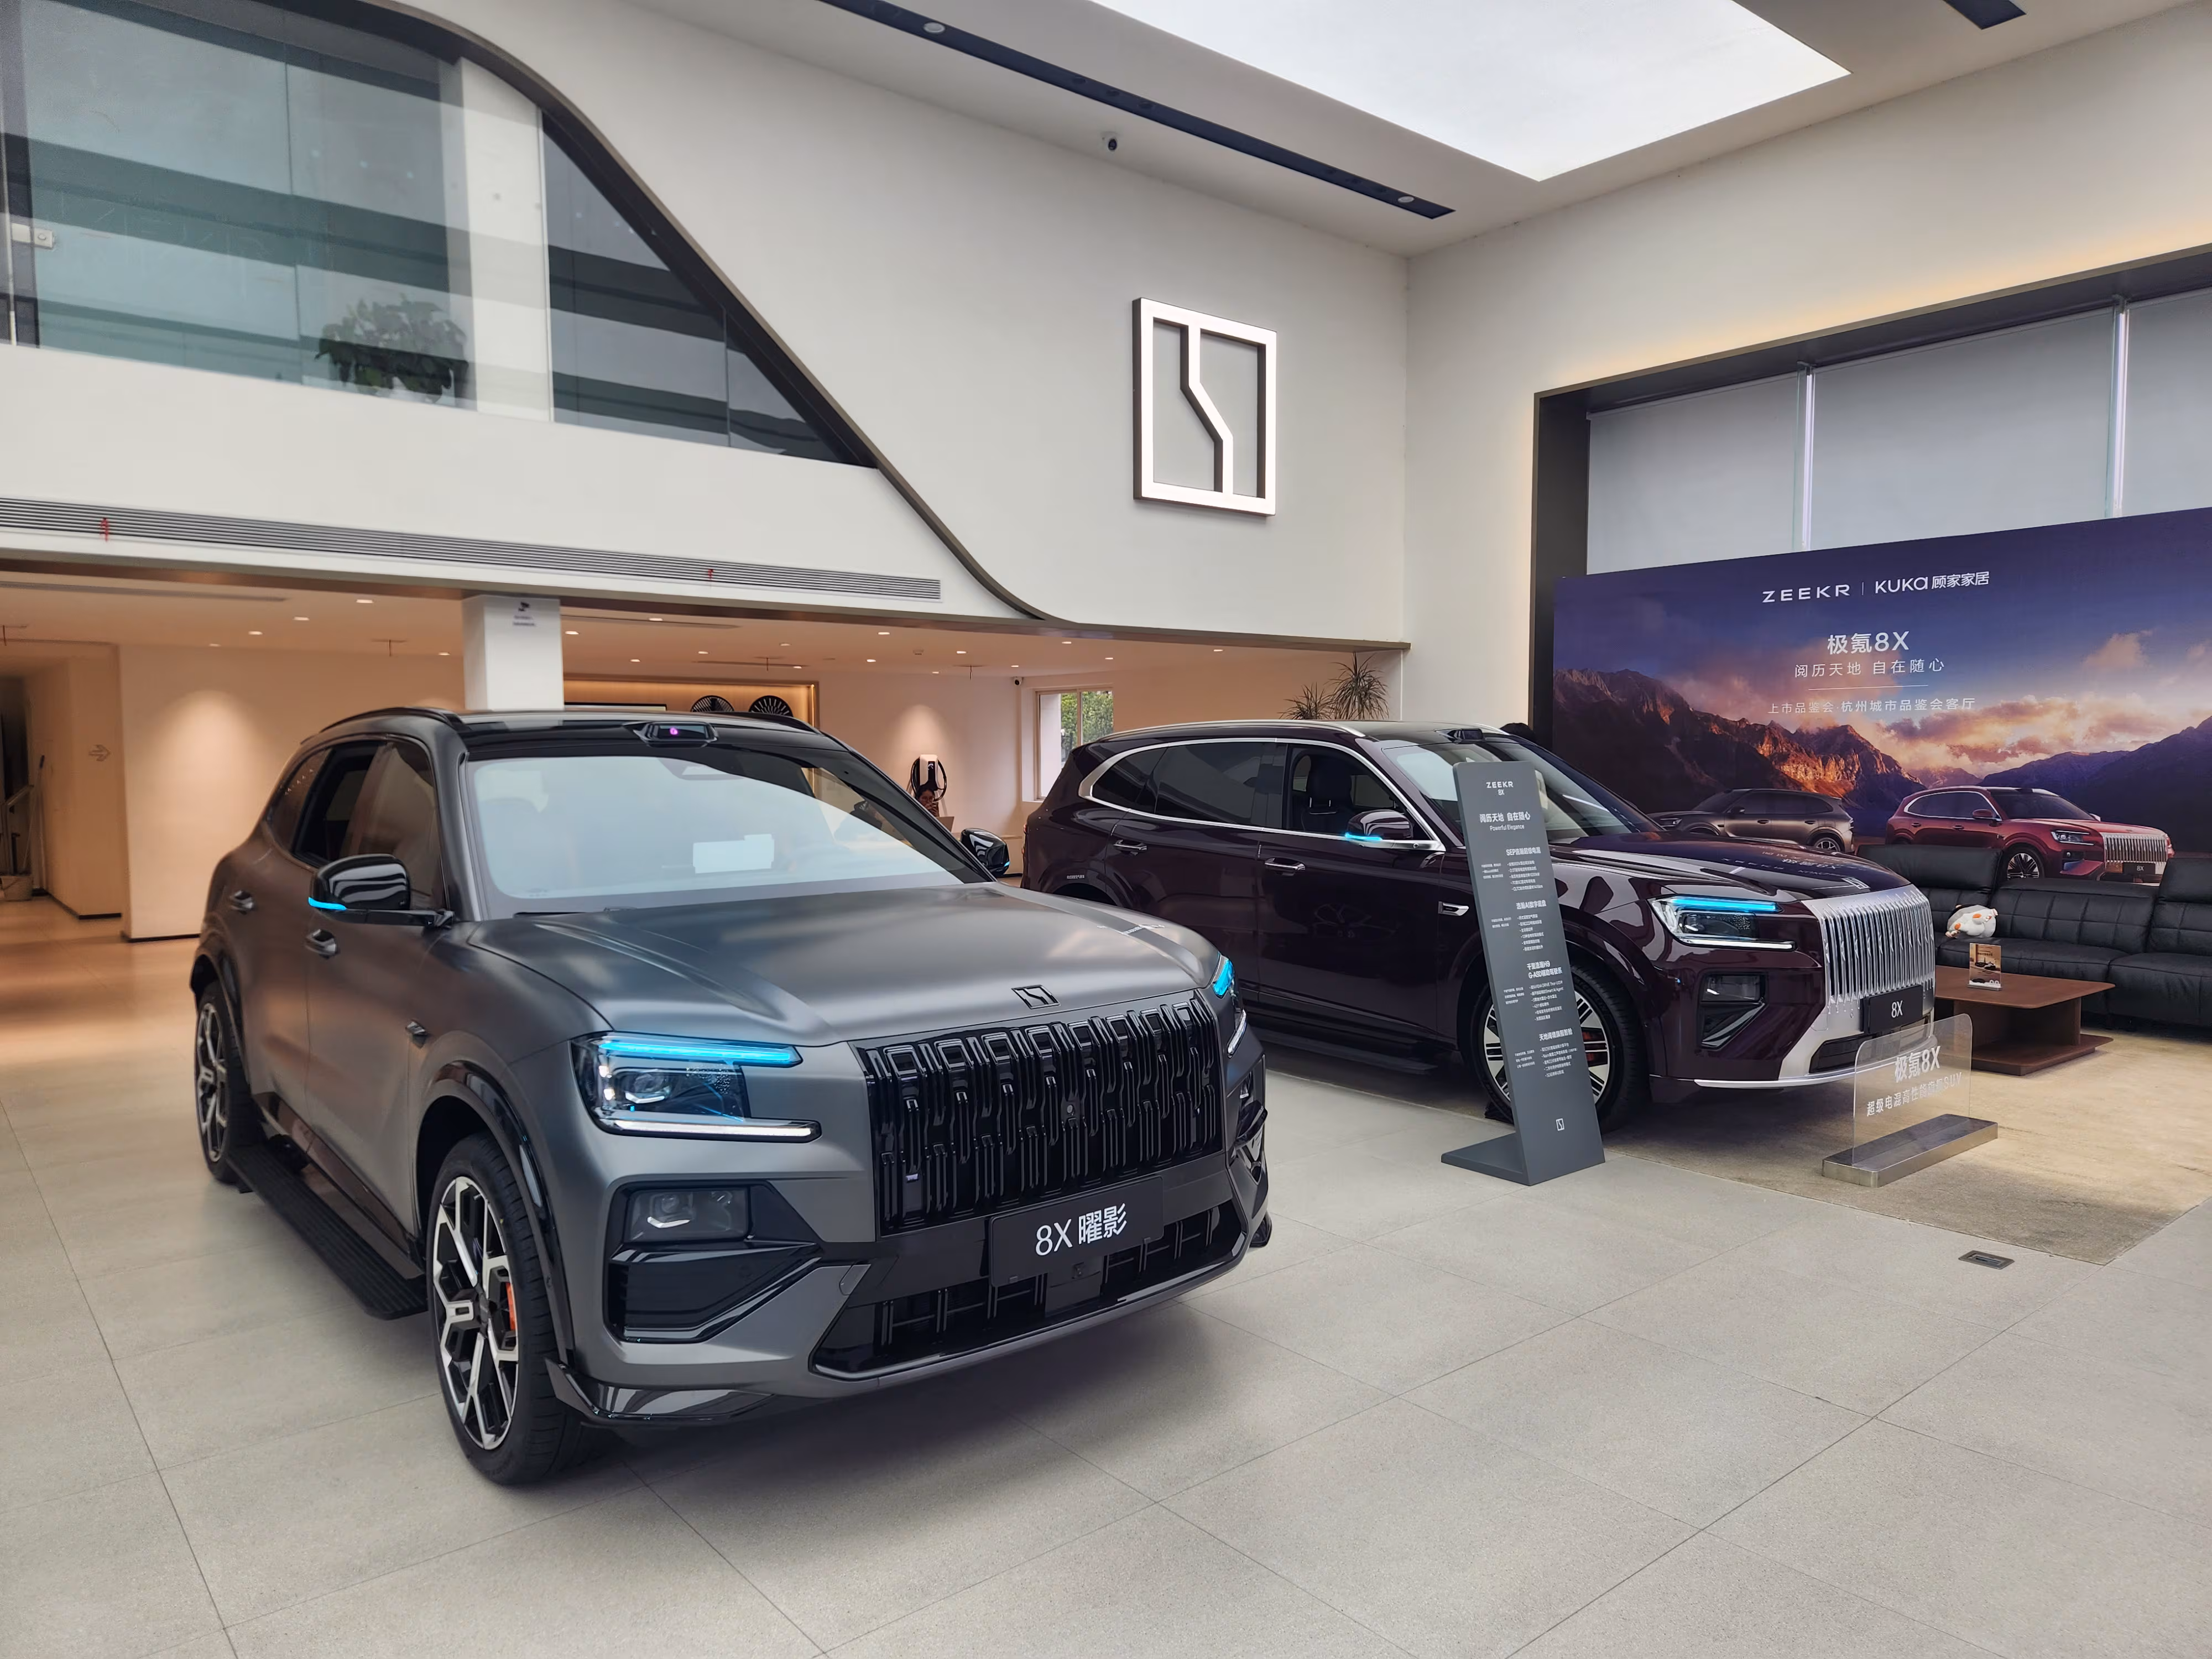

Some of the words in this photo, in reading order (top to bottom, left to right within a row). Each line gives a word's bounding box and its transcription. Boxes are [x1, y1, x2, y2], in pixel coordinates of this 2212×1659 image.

[1932, 571, 1990, 589] 顾家家居
[1762, 584, 1850, 603] ZEEKR
[1827, 631, 1910, 655] 极氪8X
[1794, 662, 1861, 678] 阅历天地
[1872, 658, 1944, 675] 自在随心
[1507, 811, 1531, 821] 自在随心
[1891, 1000, 1903, 1018] 8X
[1895, 1046, 1941, 1083] 极氪8X
[1035, 1219, 1073, 1256] 8X
[1078, 1203, 1127, 1245] 曜影
